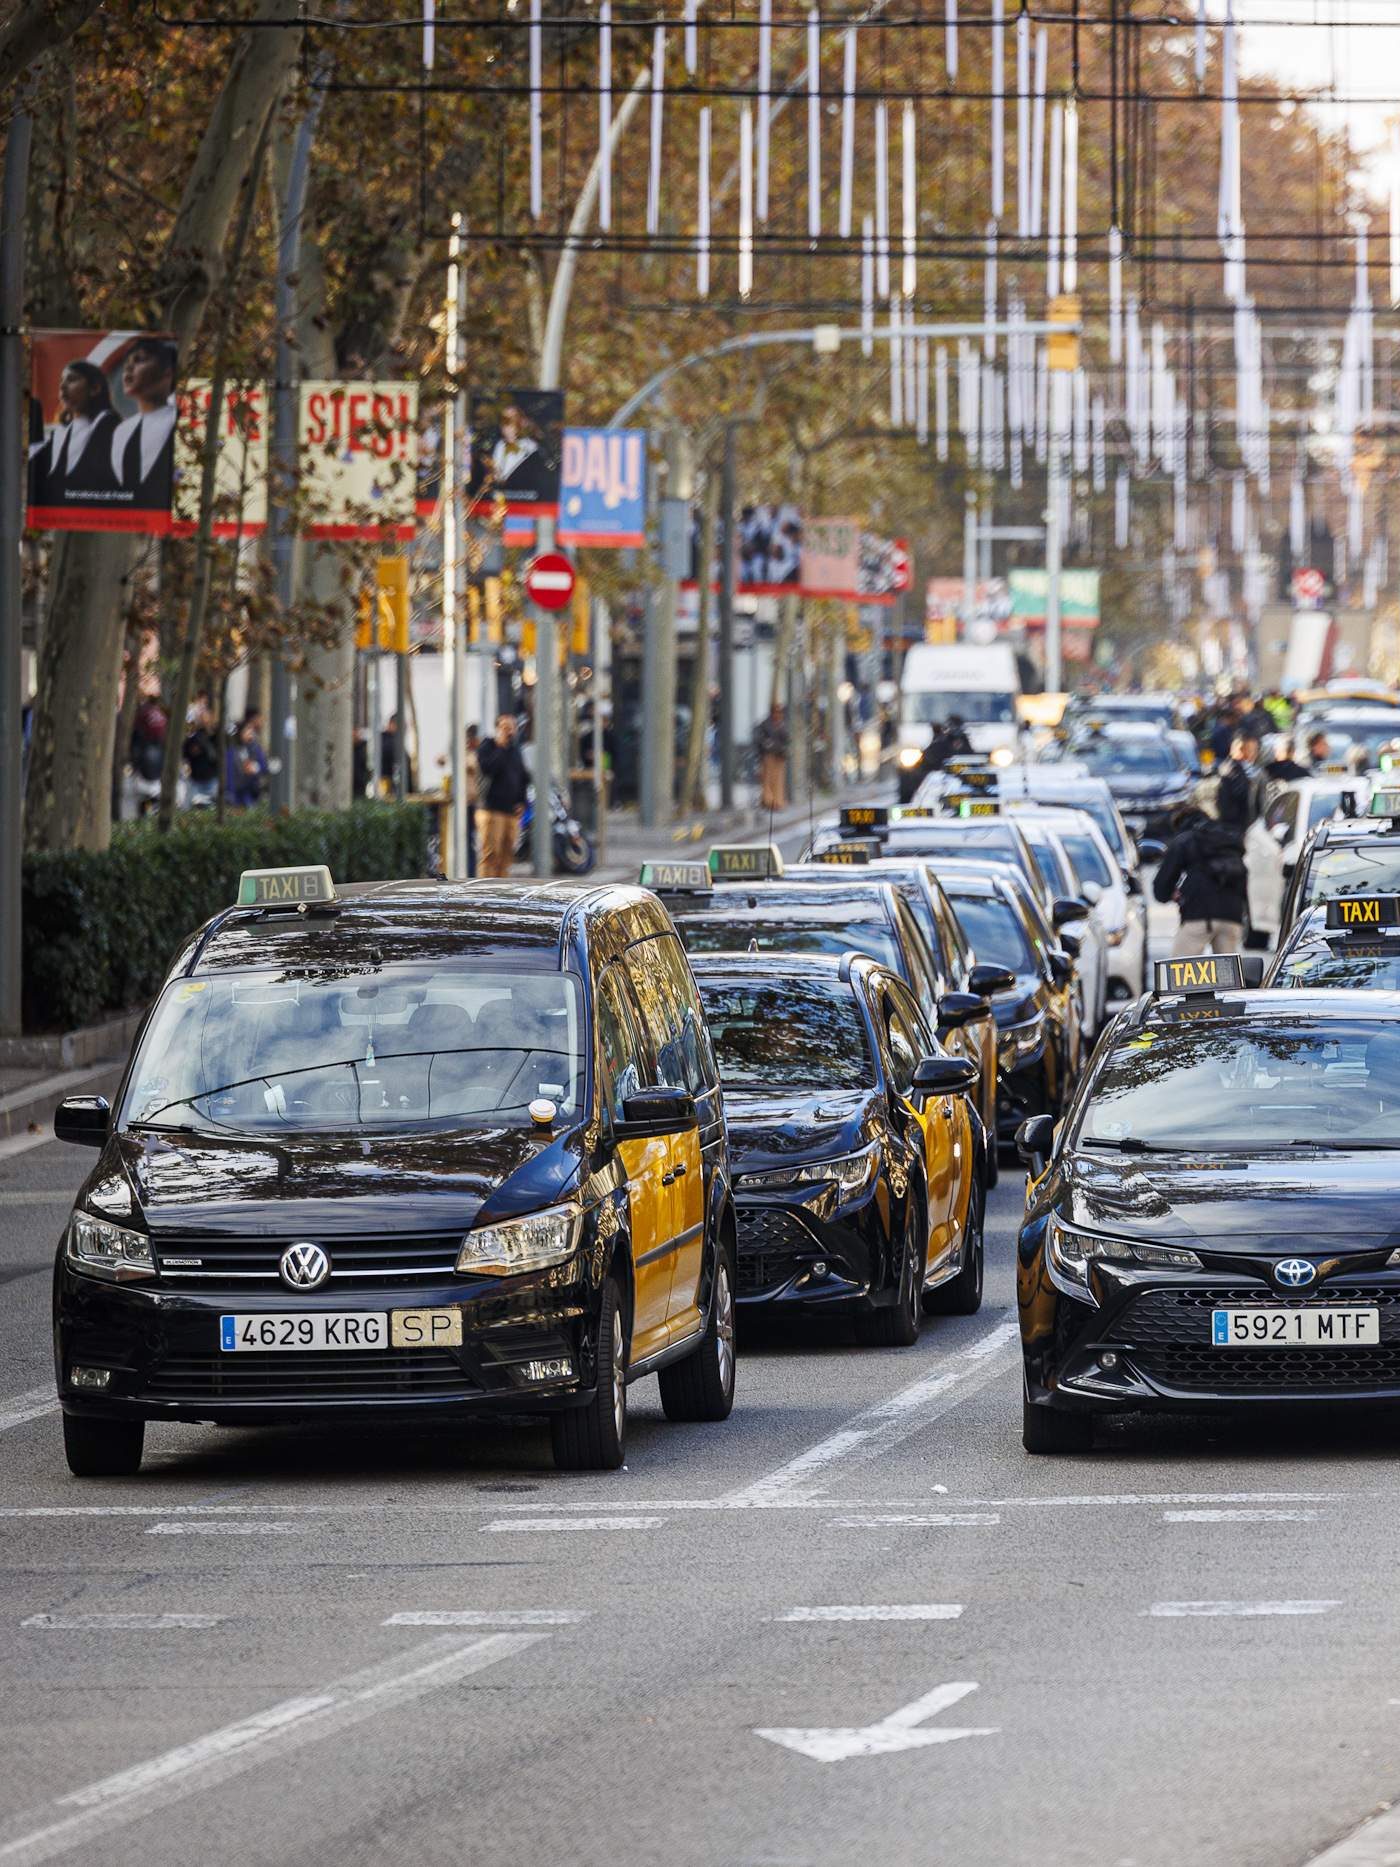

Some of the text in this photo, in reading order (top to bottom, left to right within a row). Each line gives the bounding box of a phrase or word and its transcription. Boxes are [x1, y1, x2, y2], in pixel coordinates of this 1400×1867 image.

[722, 852, 756, 872] TAXI
[260, 875, 299, 900] TAXI
[656, 865, 686, 886] TAXI
[1339, 900, 1380, 923] TAXI
[1169, 961, 1217, 987] TAXI
[241, 1318, 315, 1346] 4629
[324, 1317, 380, 1345] KRG
[1233, 1314, 1303, 1340] 5921
[1317, 1313, 1371, 1340] MTF
